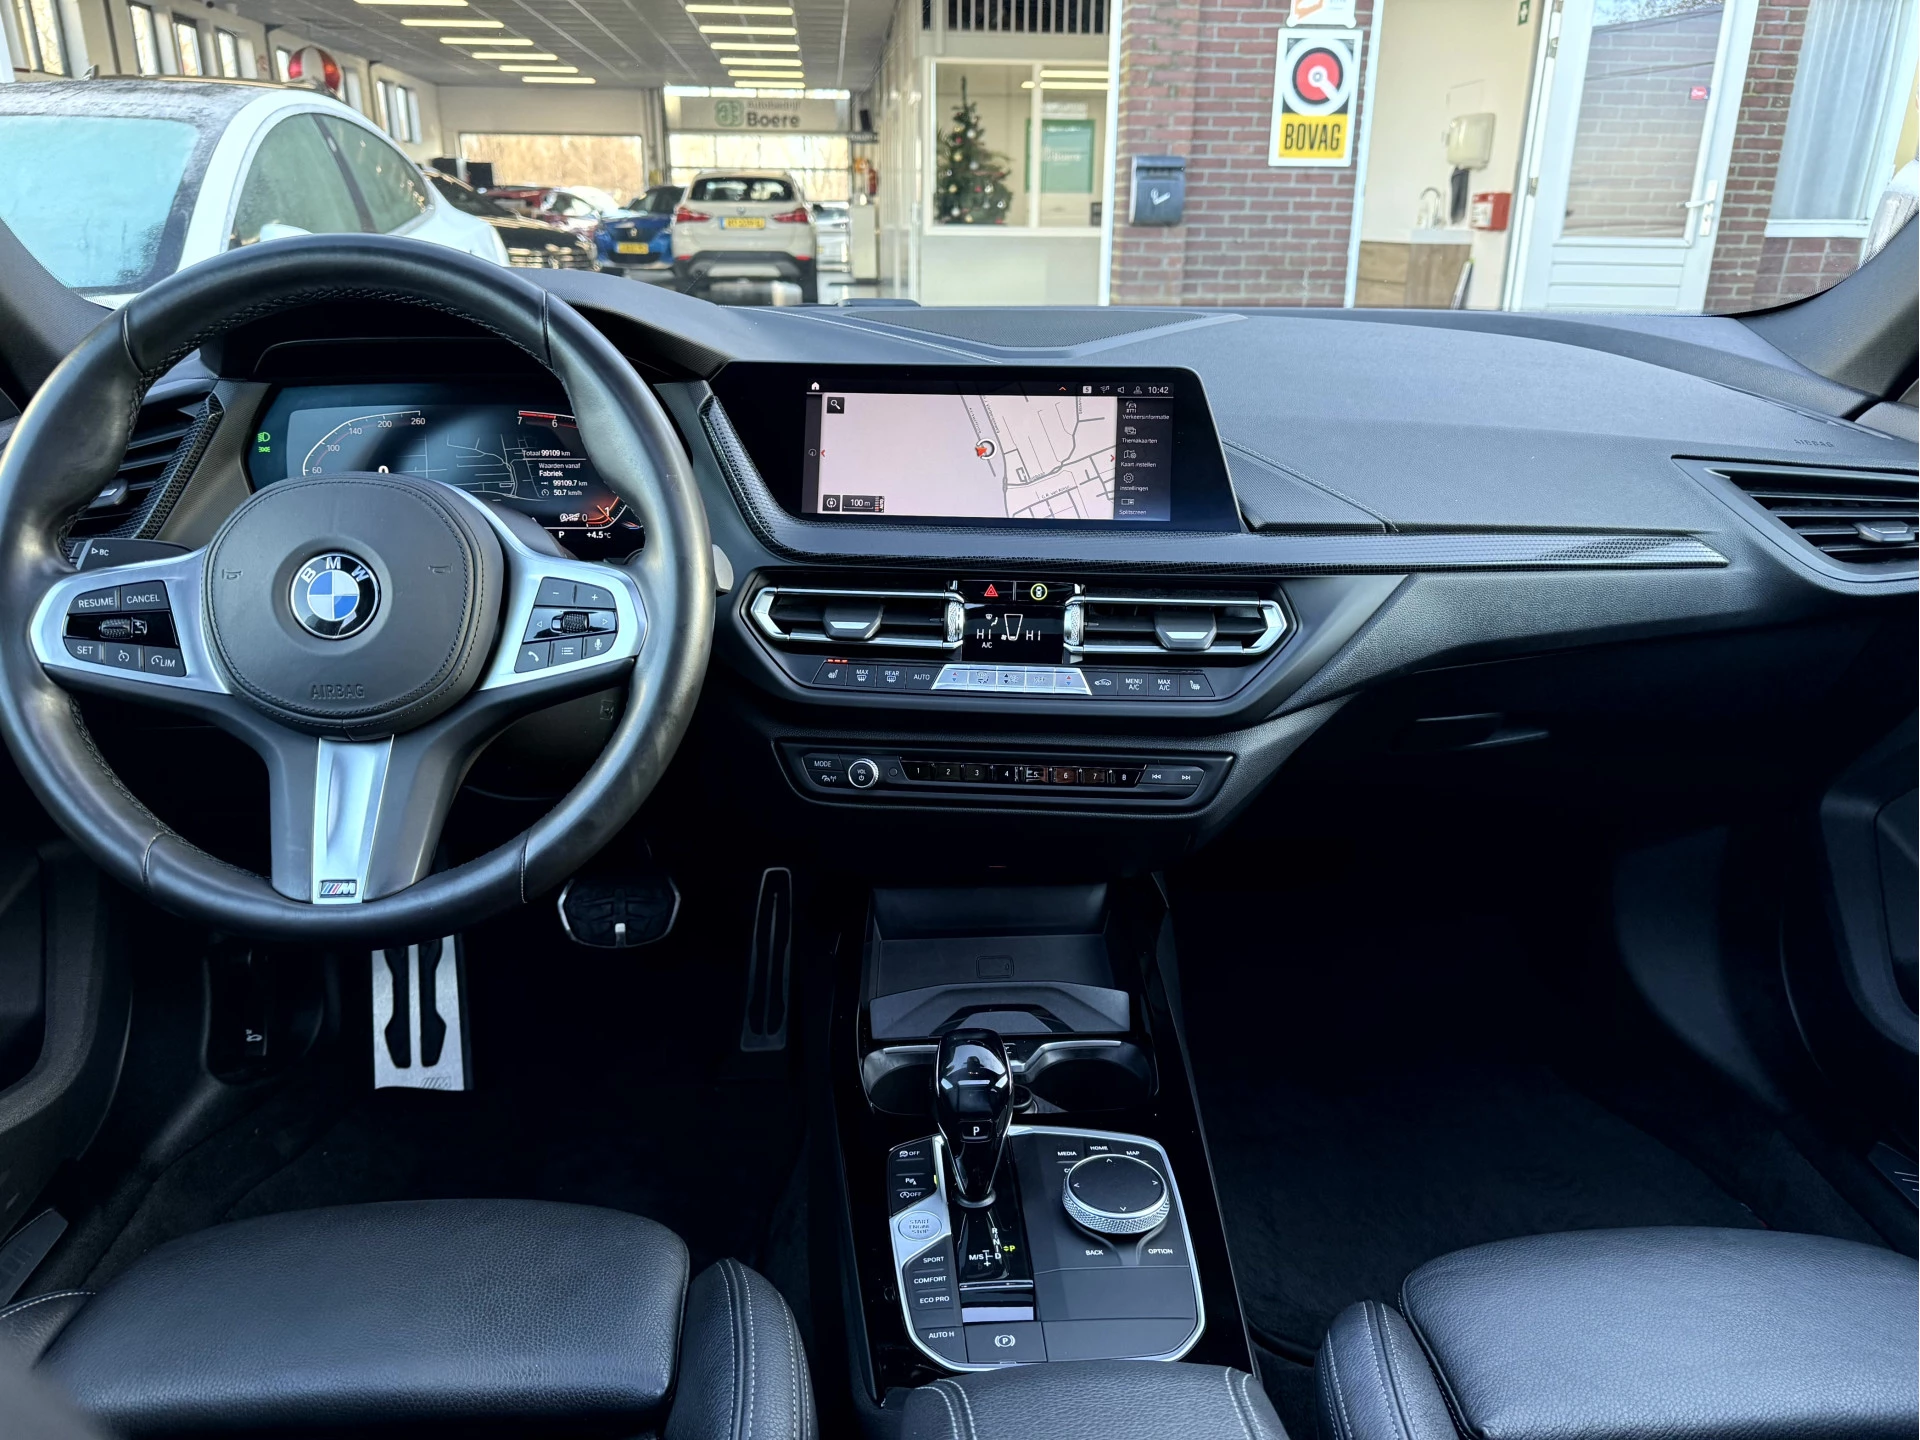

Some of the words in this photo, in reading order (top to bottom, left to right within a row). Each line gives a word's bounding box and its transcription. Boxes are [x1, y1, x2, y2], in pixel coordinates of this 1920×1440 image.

[747, 112, 800, 128] Boere
[1284, 124, 1340, 150] BOVAG
[517, 416, 522, 425] 7
[552, 419, 558, 428] 6
[301, 557, 369, 583] BMW
[78, 597, 114, 608] RESUME
[126, 594, 160, 604] CANCEL
[77, 646, 93, 654] SET
[160, 659, 175, 668] LIM
[312, 684, 365, 699] AIRBAG
[973, 1126, 980, 1136] P
[914, 1276, 947, 1284] COMFORT
